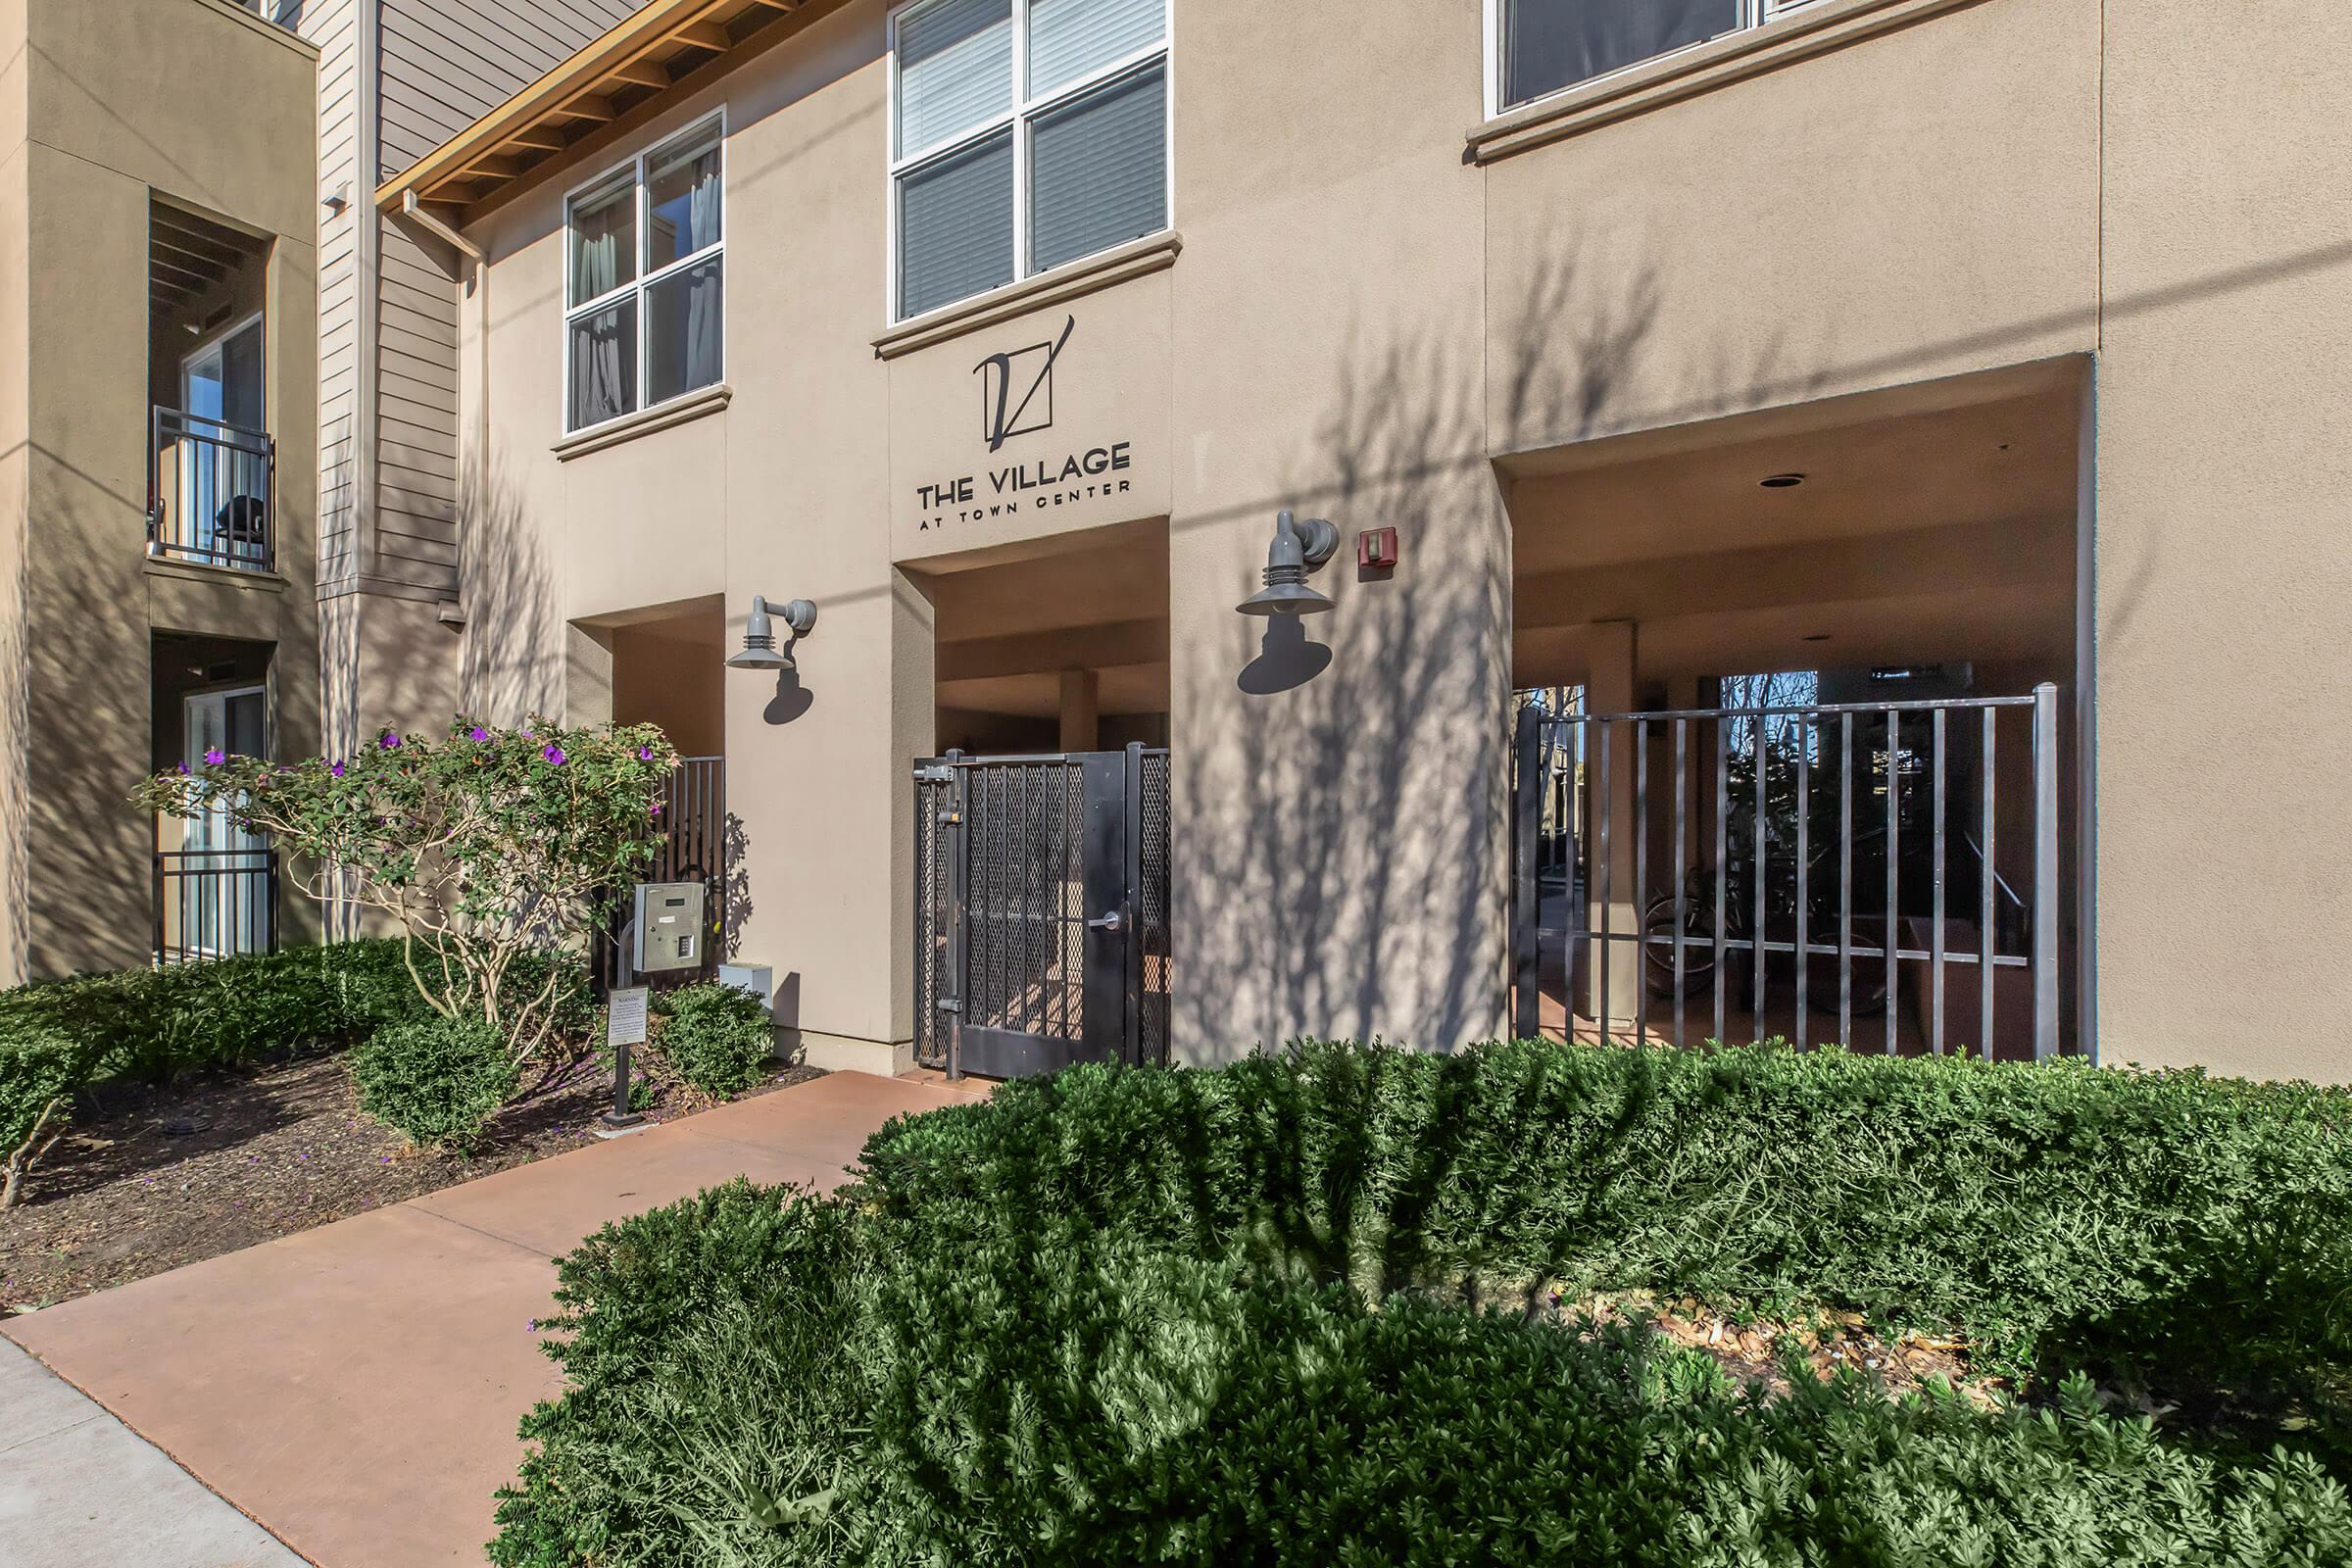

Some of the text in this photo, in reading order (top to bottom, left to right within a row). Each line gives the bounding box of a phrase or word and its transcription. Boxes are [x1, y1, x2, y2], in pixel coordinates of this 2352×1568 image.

[916, 441, 1130, 510] THE VILLAGE
[919, 480, 1130, 531] AT TOWN CENTER
